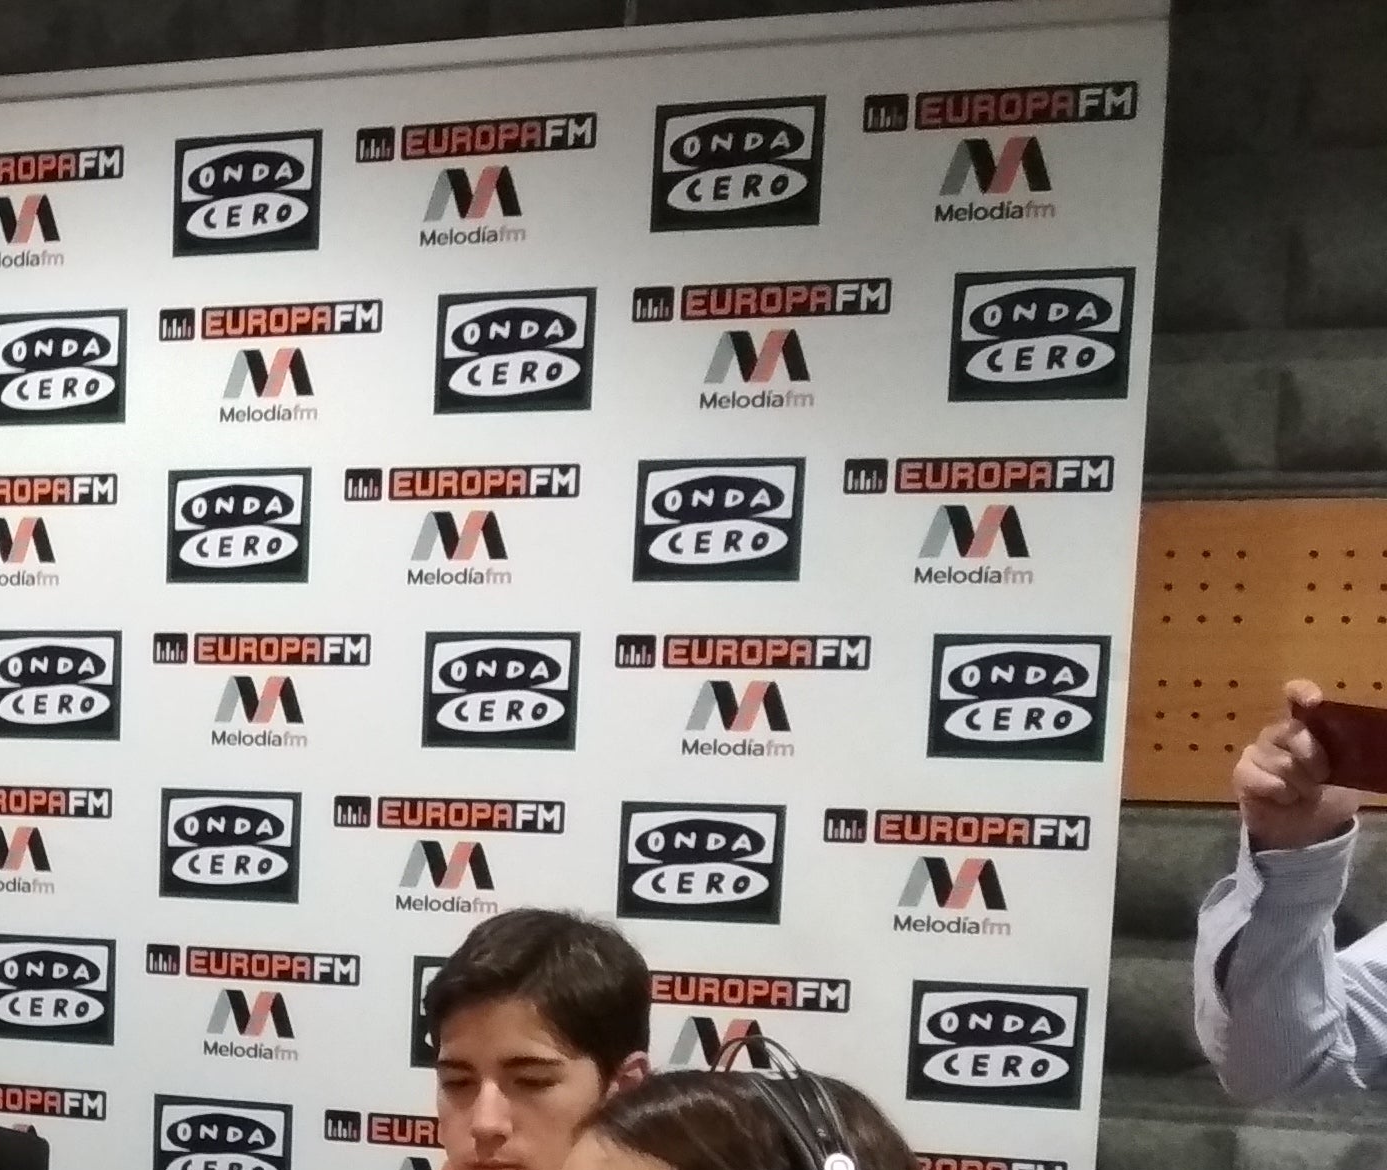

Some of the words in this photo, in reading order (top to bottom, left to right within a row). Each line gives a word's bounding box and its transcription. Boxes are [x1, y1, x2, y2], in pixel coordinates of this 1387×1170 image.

[919, 84, 1134, 125] EUROPAFM
[406, 116, 592, 156] EUROPAFM
[682, 129, 791, 158] ONDA
[199, 160, 292, 188] ONDA
[686, 174, 789, 202] CERO
[203, 203, 291, 229] CERO
[934, 198, 1056, 222] Melodíafm
[420, 223, 527, 246] Melodíafm
[686, 281, 887, 316] EUROPAFM
[205, 303, 378, 335] EUROPAFM
[983, 300, 1097, 328] ONDA
[463, 318, 563, 345] ONDA
[12, 338, 99, 362] ONDA
[987, 346, 1095, 372] CERO
[467, 361, 562, 386] CERO
[17, 377, 99, 400] CERO
[699, 389, 815, 409] Melodíafm
[220, 404, 317, 422] Melodíafm
[392, 467, 575, 496] EUROPAFM
[900, 459, 1109, 489] EUROPAFM
[191, 496, 282, 519] ONDA
[664, 487, 770, 512] ONDA
[196, 535, 281, 558] CERO
[668, 530, 769, 554] CERO
[407, 567, 511, 585] Melodíafm
[914, 565, 1033, 584] Melodíafm
[198, 636, 367, 662] EUROPAFM
[667, 638, 866, 666] EUROPAFM
[8, 656, 94, 677] ONDA
[450, 660, 548, 682] ONDA
[961, 664, 1074, 688] ONDA
[13, 694, 94, 714] CERO
[454, 700, 547, 722] CERO
[965, 707, 1072, 731] CERO
[211, 730, 307, 747] Melodíafm
[681, 738, 794, 757] Melodíafm
[184, 815, 273, 836] ONDA
[381, 800, 561, 830] EUROPAFM
[647, 830, 751, 853] ONDA
[879, 813, 1085, 847] EUROPAFM
[188, 854, 272, 875] CERO
[651, 872, 750, 894] CERO
[396, 894, 498, 913] Melodíafm
[893, 914, 1011, 935] Melodíafm
[4, 959, 89, 979] ONDA
[190, 950, 356, 983] EUROPAFM
[8, 996, 89, 1017] CERO
[940, 1011, 1051, 1034] ONDA
[203, 1040, 298, 1060] Melodíafm
[943, 1053, 1049, 1078] CERO
[177, 1122, 264, 1144] ONDA
